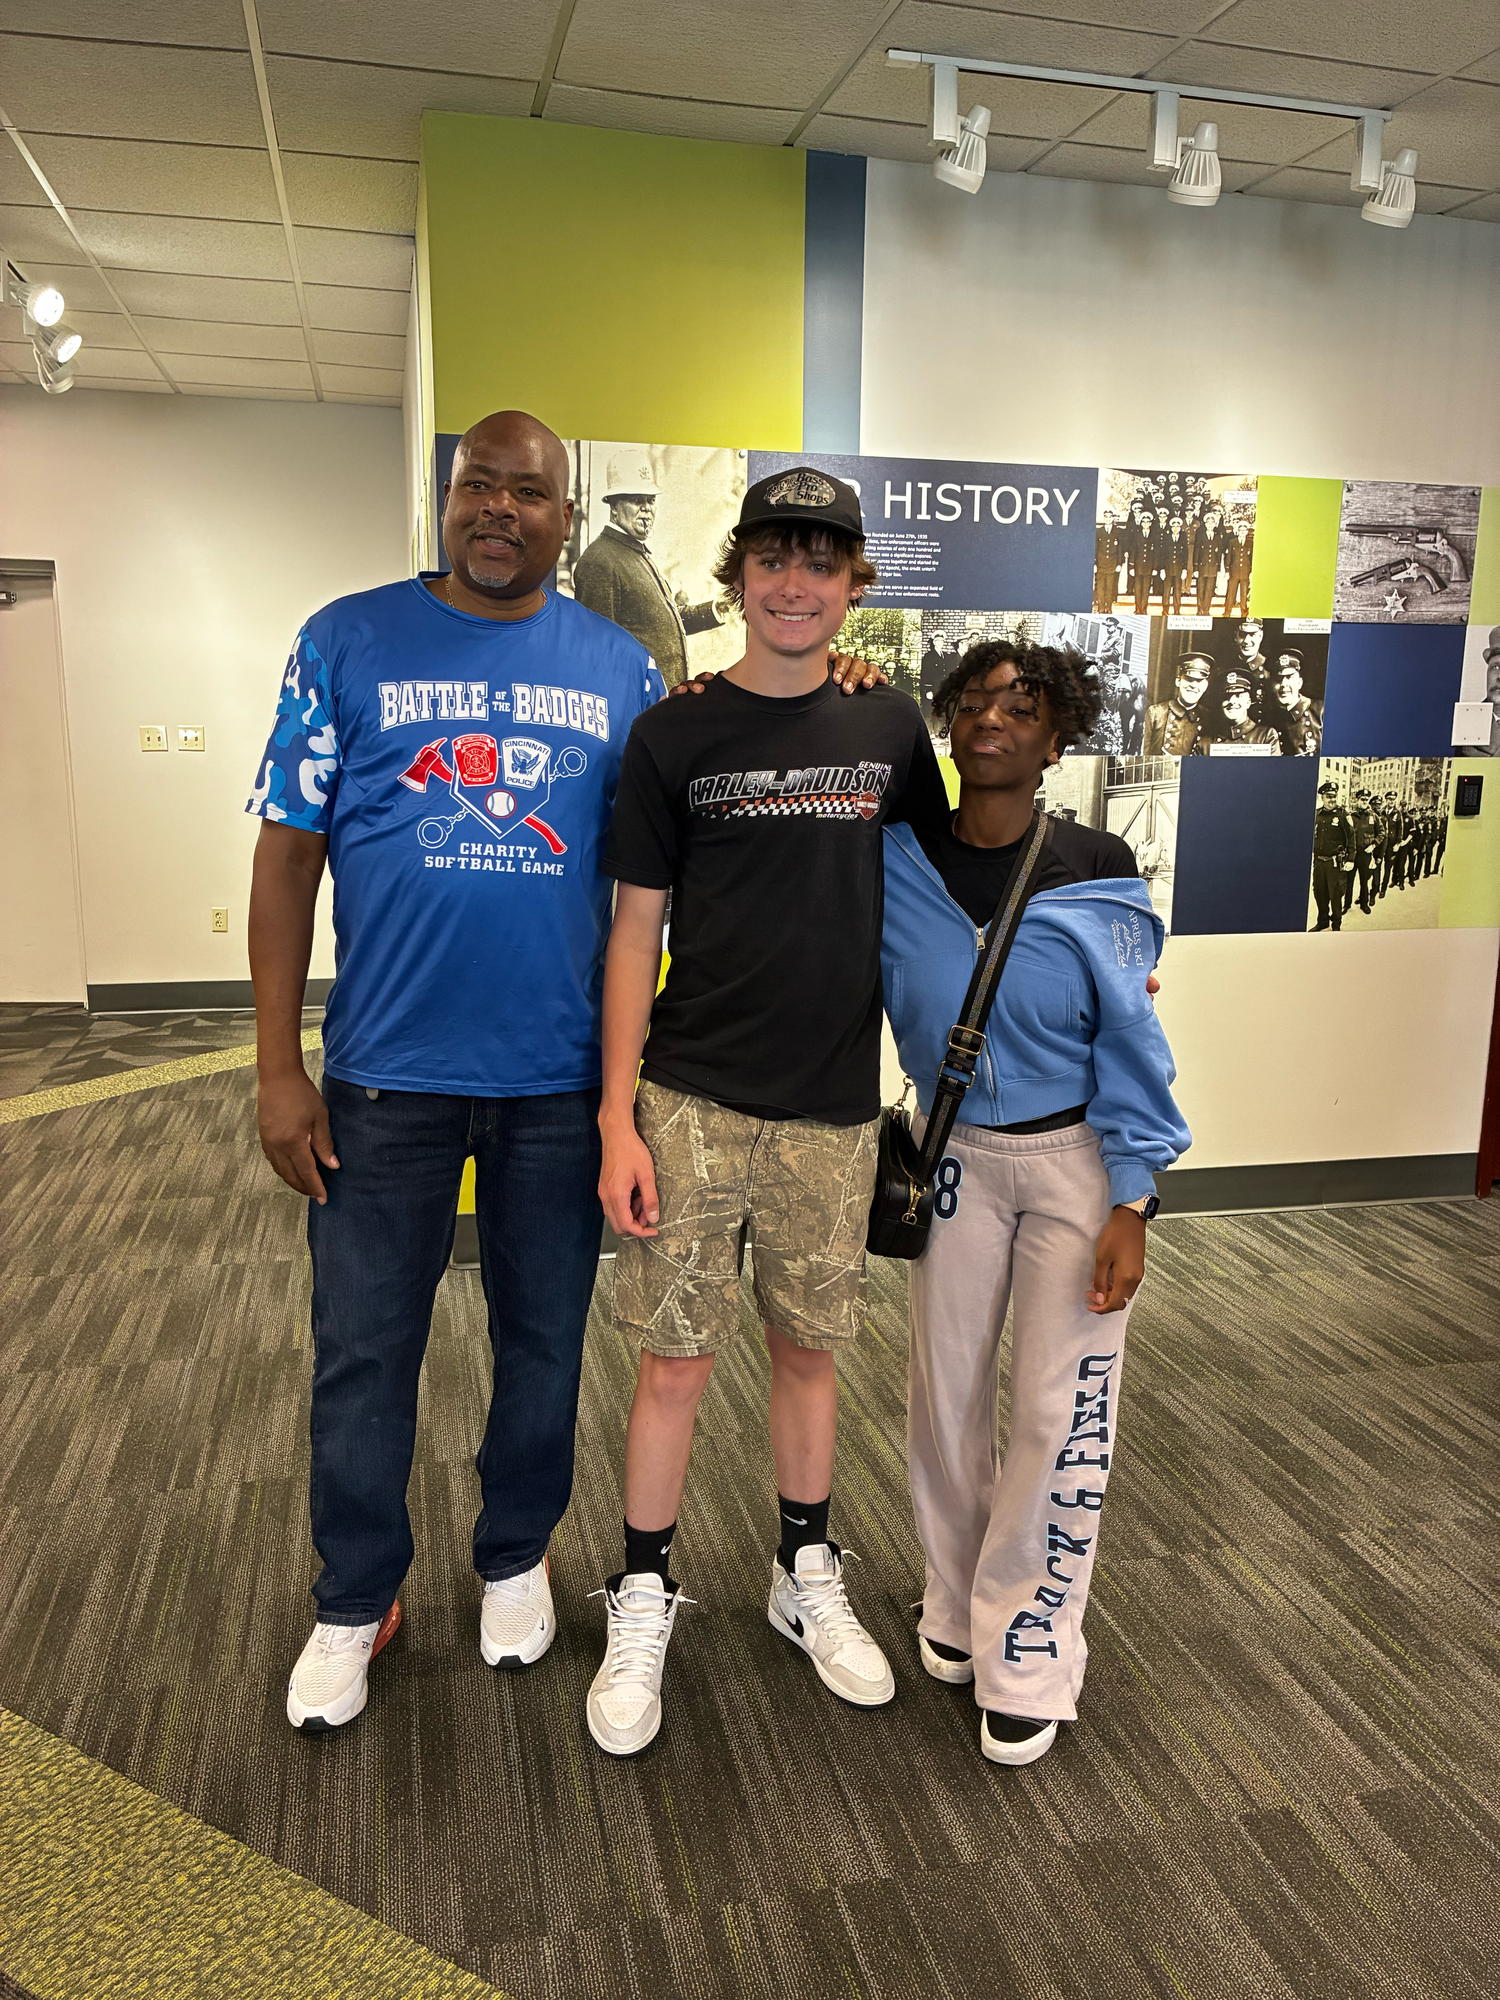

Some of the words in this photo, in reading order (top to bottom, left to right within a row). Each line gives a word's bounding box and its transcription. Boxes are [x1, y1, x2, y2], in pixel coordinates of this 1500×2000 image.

[797, 473, 824, 485] Bass
[797, 481, 818, 492] Pro
[795, 491, 829, 505] Shops
[884, 480, 1081, 526] HISTORY
[378, 680, 489, 732] BATTLE
[495, 691, 507, 701] OF
[492, 700, 511, 713] THE
[512, 683, 610, 743] BADGES
[504, 740, 549, 755] CINCINNATI
[506, 776, 535, 787] POLICE
[689, 766, 891, 808] HARLEY-DAVIDSON
[815, 812, 859, 820] motorcycles
[460, 842, 538, 859] CHARITY
[424, 855, 516, 873] SOFTBALL
[522, 861, 565, 876] GAME
[1134, 947, 1144, 967] SKI
[933, 1156, 963, 1221] 8
[1054, 1350, 1118, 1473] FIELD
[1050, 1488, 1105, 1512] &
[1003, 1521, 1093, 1664] TRACK
